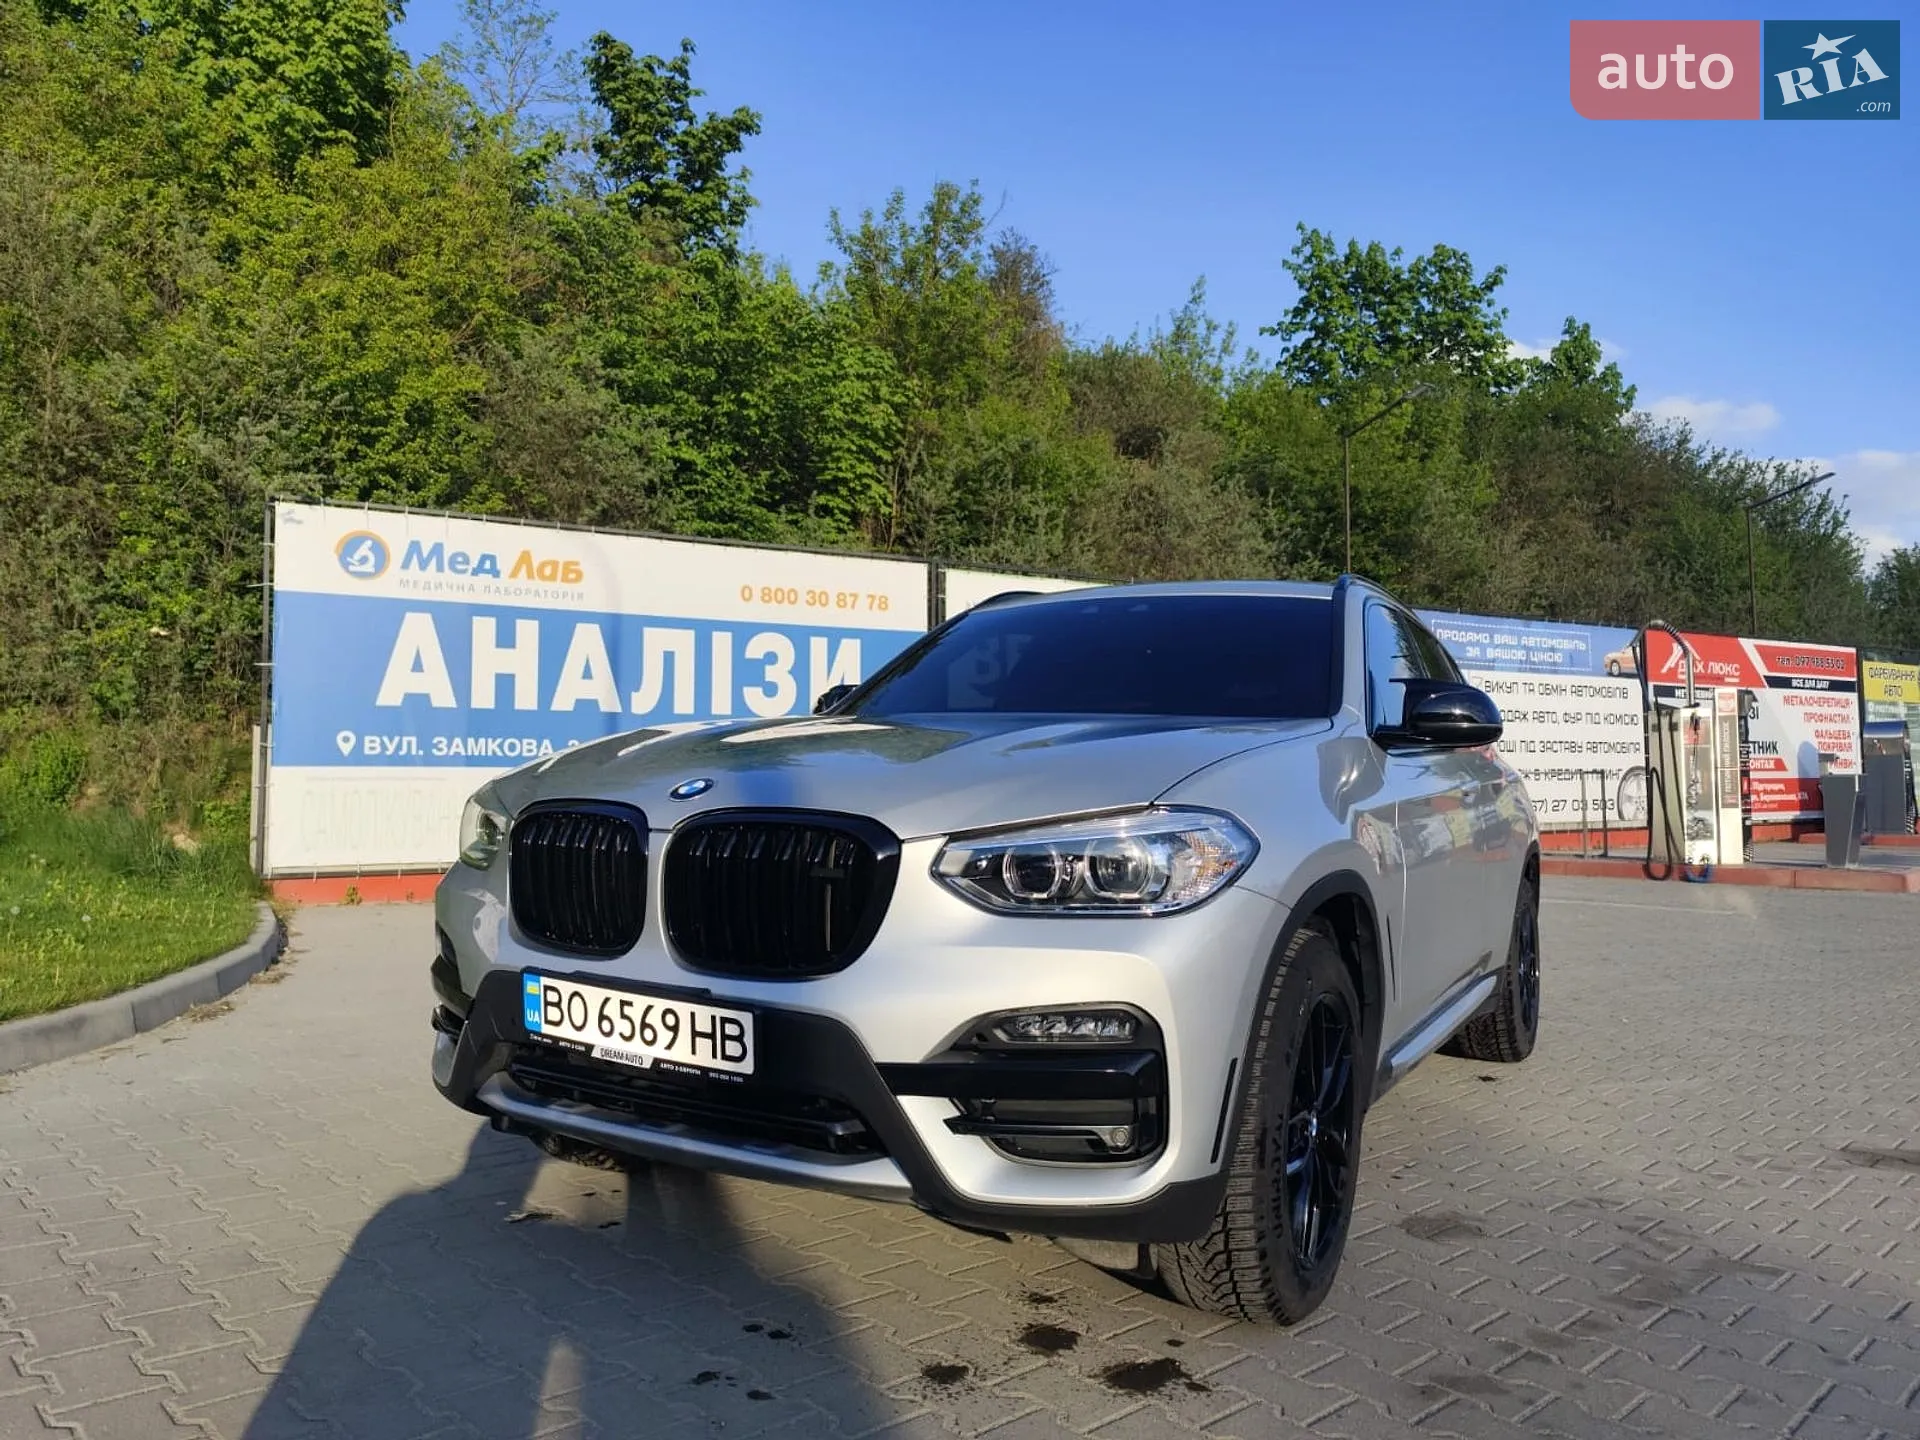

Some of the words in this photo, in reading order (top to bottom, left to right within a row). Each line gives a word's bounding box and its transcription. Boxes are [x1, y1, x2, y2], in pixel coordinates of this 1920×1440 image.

[400, 539, 501, 578] Мед
[508, 549, 585, 585] Лаб
[400, 578, 475, 593] МЕДИЧНА
[483, 583, 585, 601] ЛАБОРАТОРІЯ
[741, 584, 753, 602] 0
[760, 586, 798, 605] 800
[805, 589, 829, 608] 30
[836, 591, 859, 610] 87
[866, 593, 889, 612] 78
[1436, 628, 1490, 644] ПРОДАМО
[1494, 634, 1518, 646] ВАШ
[1521, 636, 1586, 650] АВТОМОБІЛЬ
[375, 611, 863, 718] АНАЛІЗИ
[1466, 646, 1479, 657] ЗА
[1486, 648, 1526, 660] ВАШОЮ
[1529, 651, 1563, 664] ЦІНОЮ
[1707, 662, 1740, 675] ЛЮКС
[1484, 680, 1519, 694] ВИКУП
[1522, 681, 1535, 694] ТА
[1538, 683, 1567, 696] ОБМІН
[1570, 685, 1629, 699] АВТОМОБІЛІВ
[1563, 712, 1582, 725] ФУР
[1585, 713, 1601, 725] ПІД
[363, 735, 424, 757] ВУЛ.
[1520, 740, 1536, 753] ПІД
[1539, 741, 1583, 753] ЗАСТАВУ
[1586, 741, 1641, 754] АВТОМОБІЛЯ
[1551, 799, 1567, 812] 27
[526, 1011, 541, 1024] UA
[543, 984, 589, 1032] BO
[597, 996, 681, 1051] 6569
[689, 1011, 749, 1064] HB
